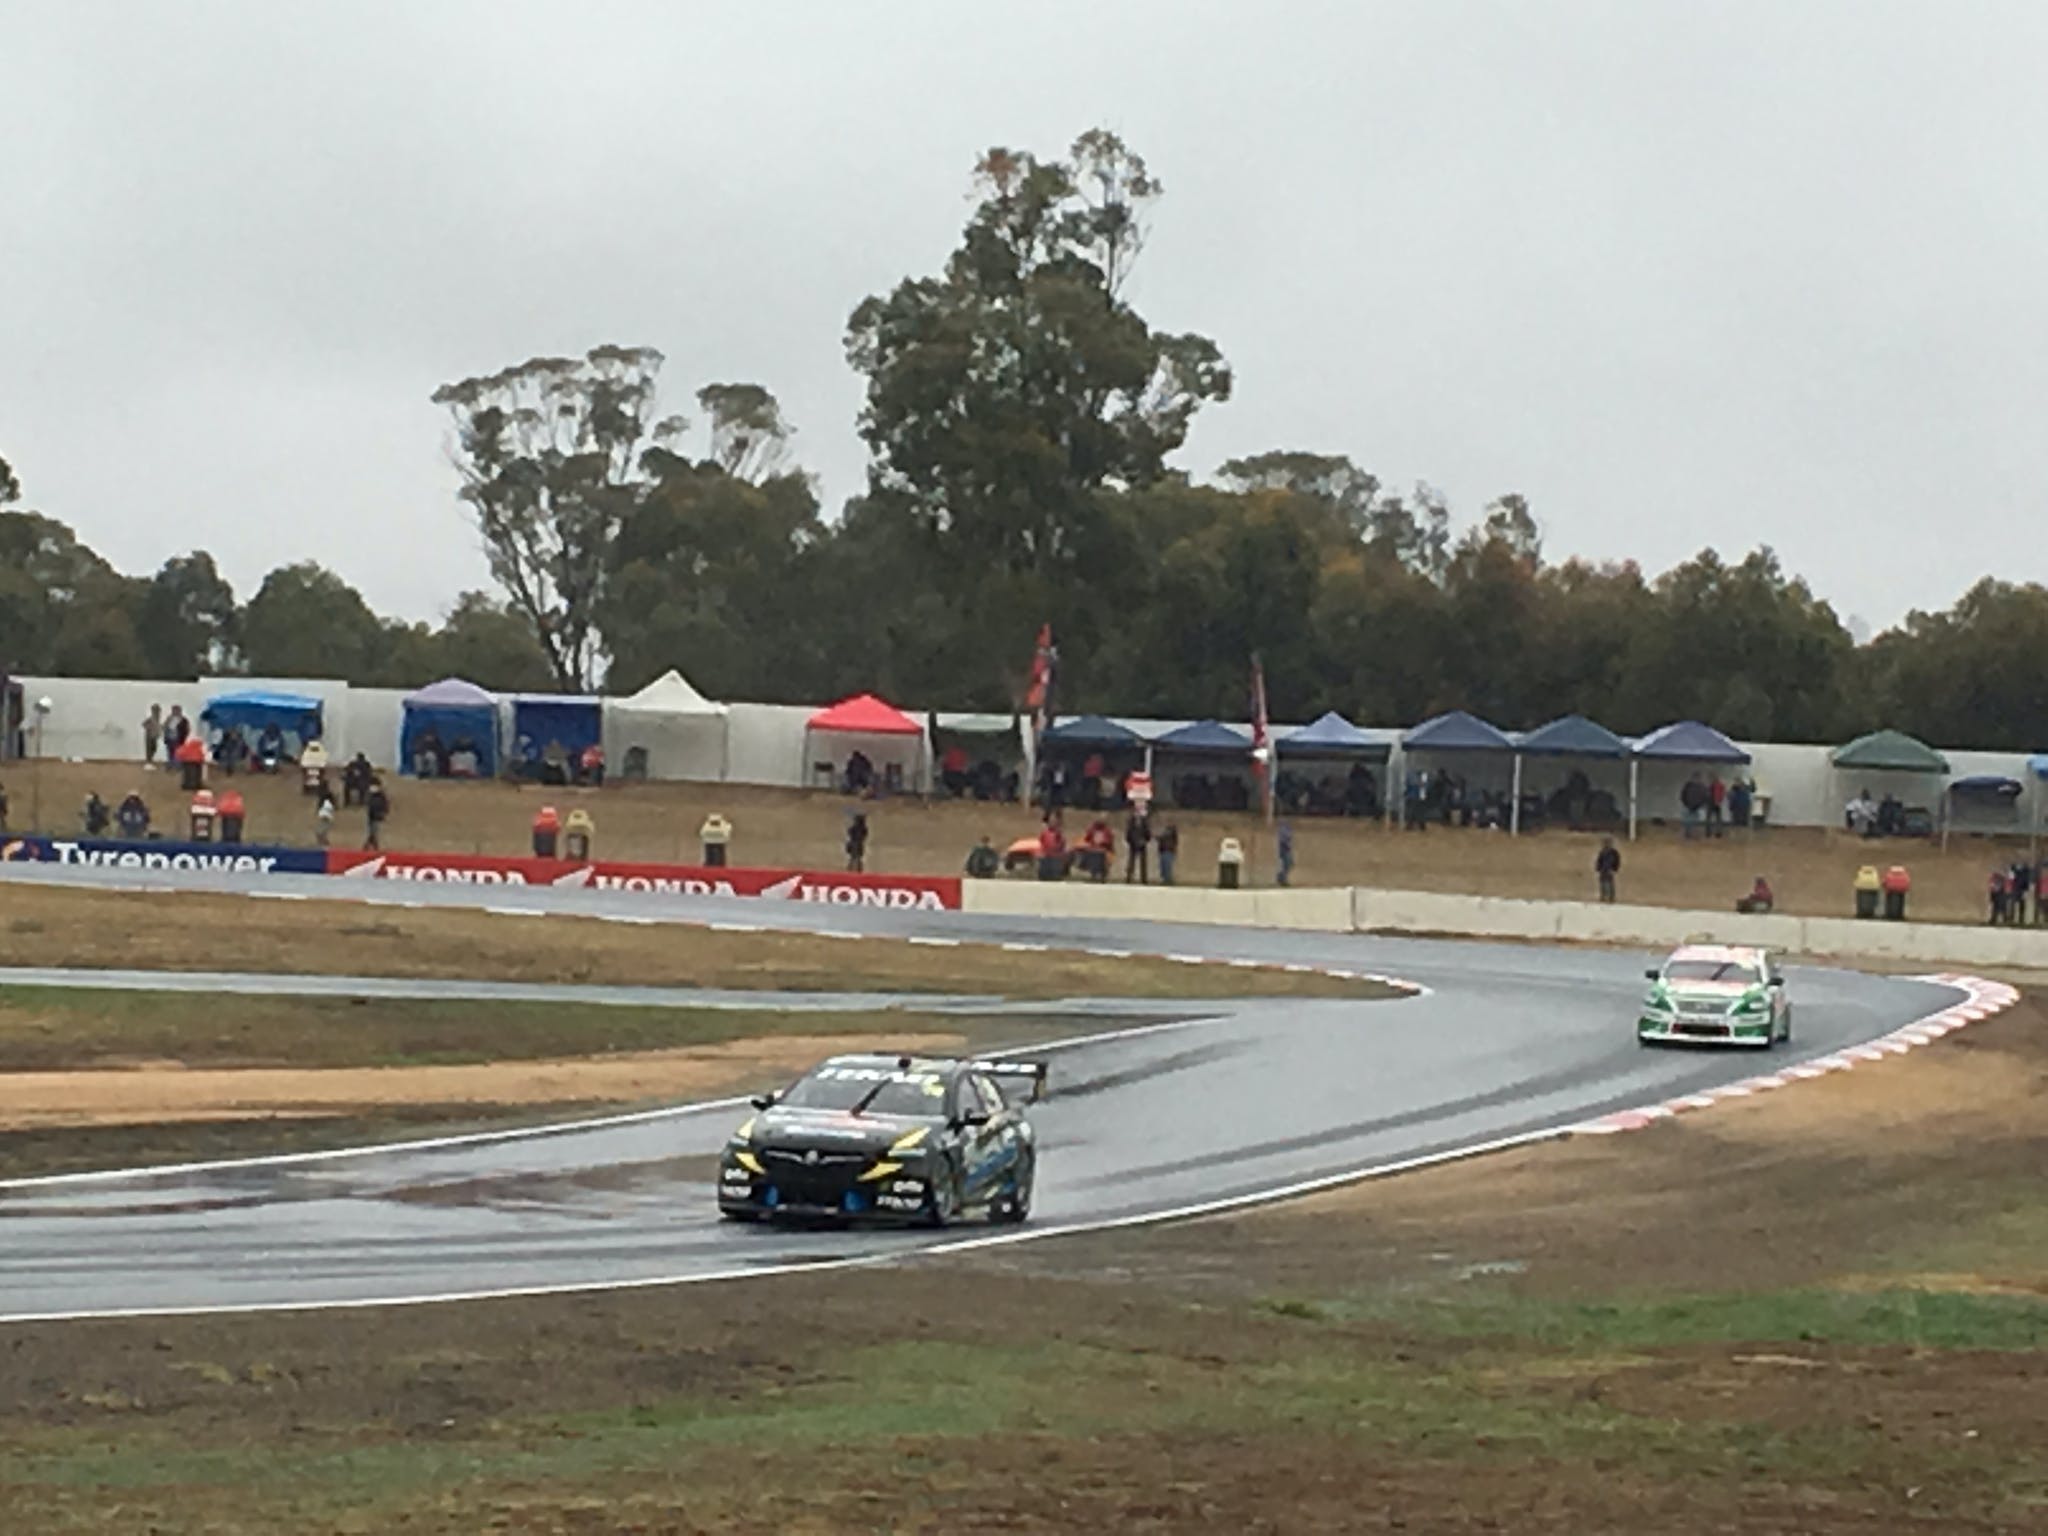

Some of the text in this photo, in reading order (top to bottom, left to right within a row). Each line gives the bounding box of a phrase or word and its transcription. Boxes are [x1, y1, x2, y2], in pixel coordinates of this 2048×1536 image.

[51, 842, 277, 874] Tyrepower
[385, 865, 527, 886] HONDA
[595, 876, 737, 897] HONDA
[801, 885, 946, 911] HONDA
